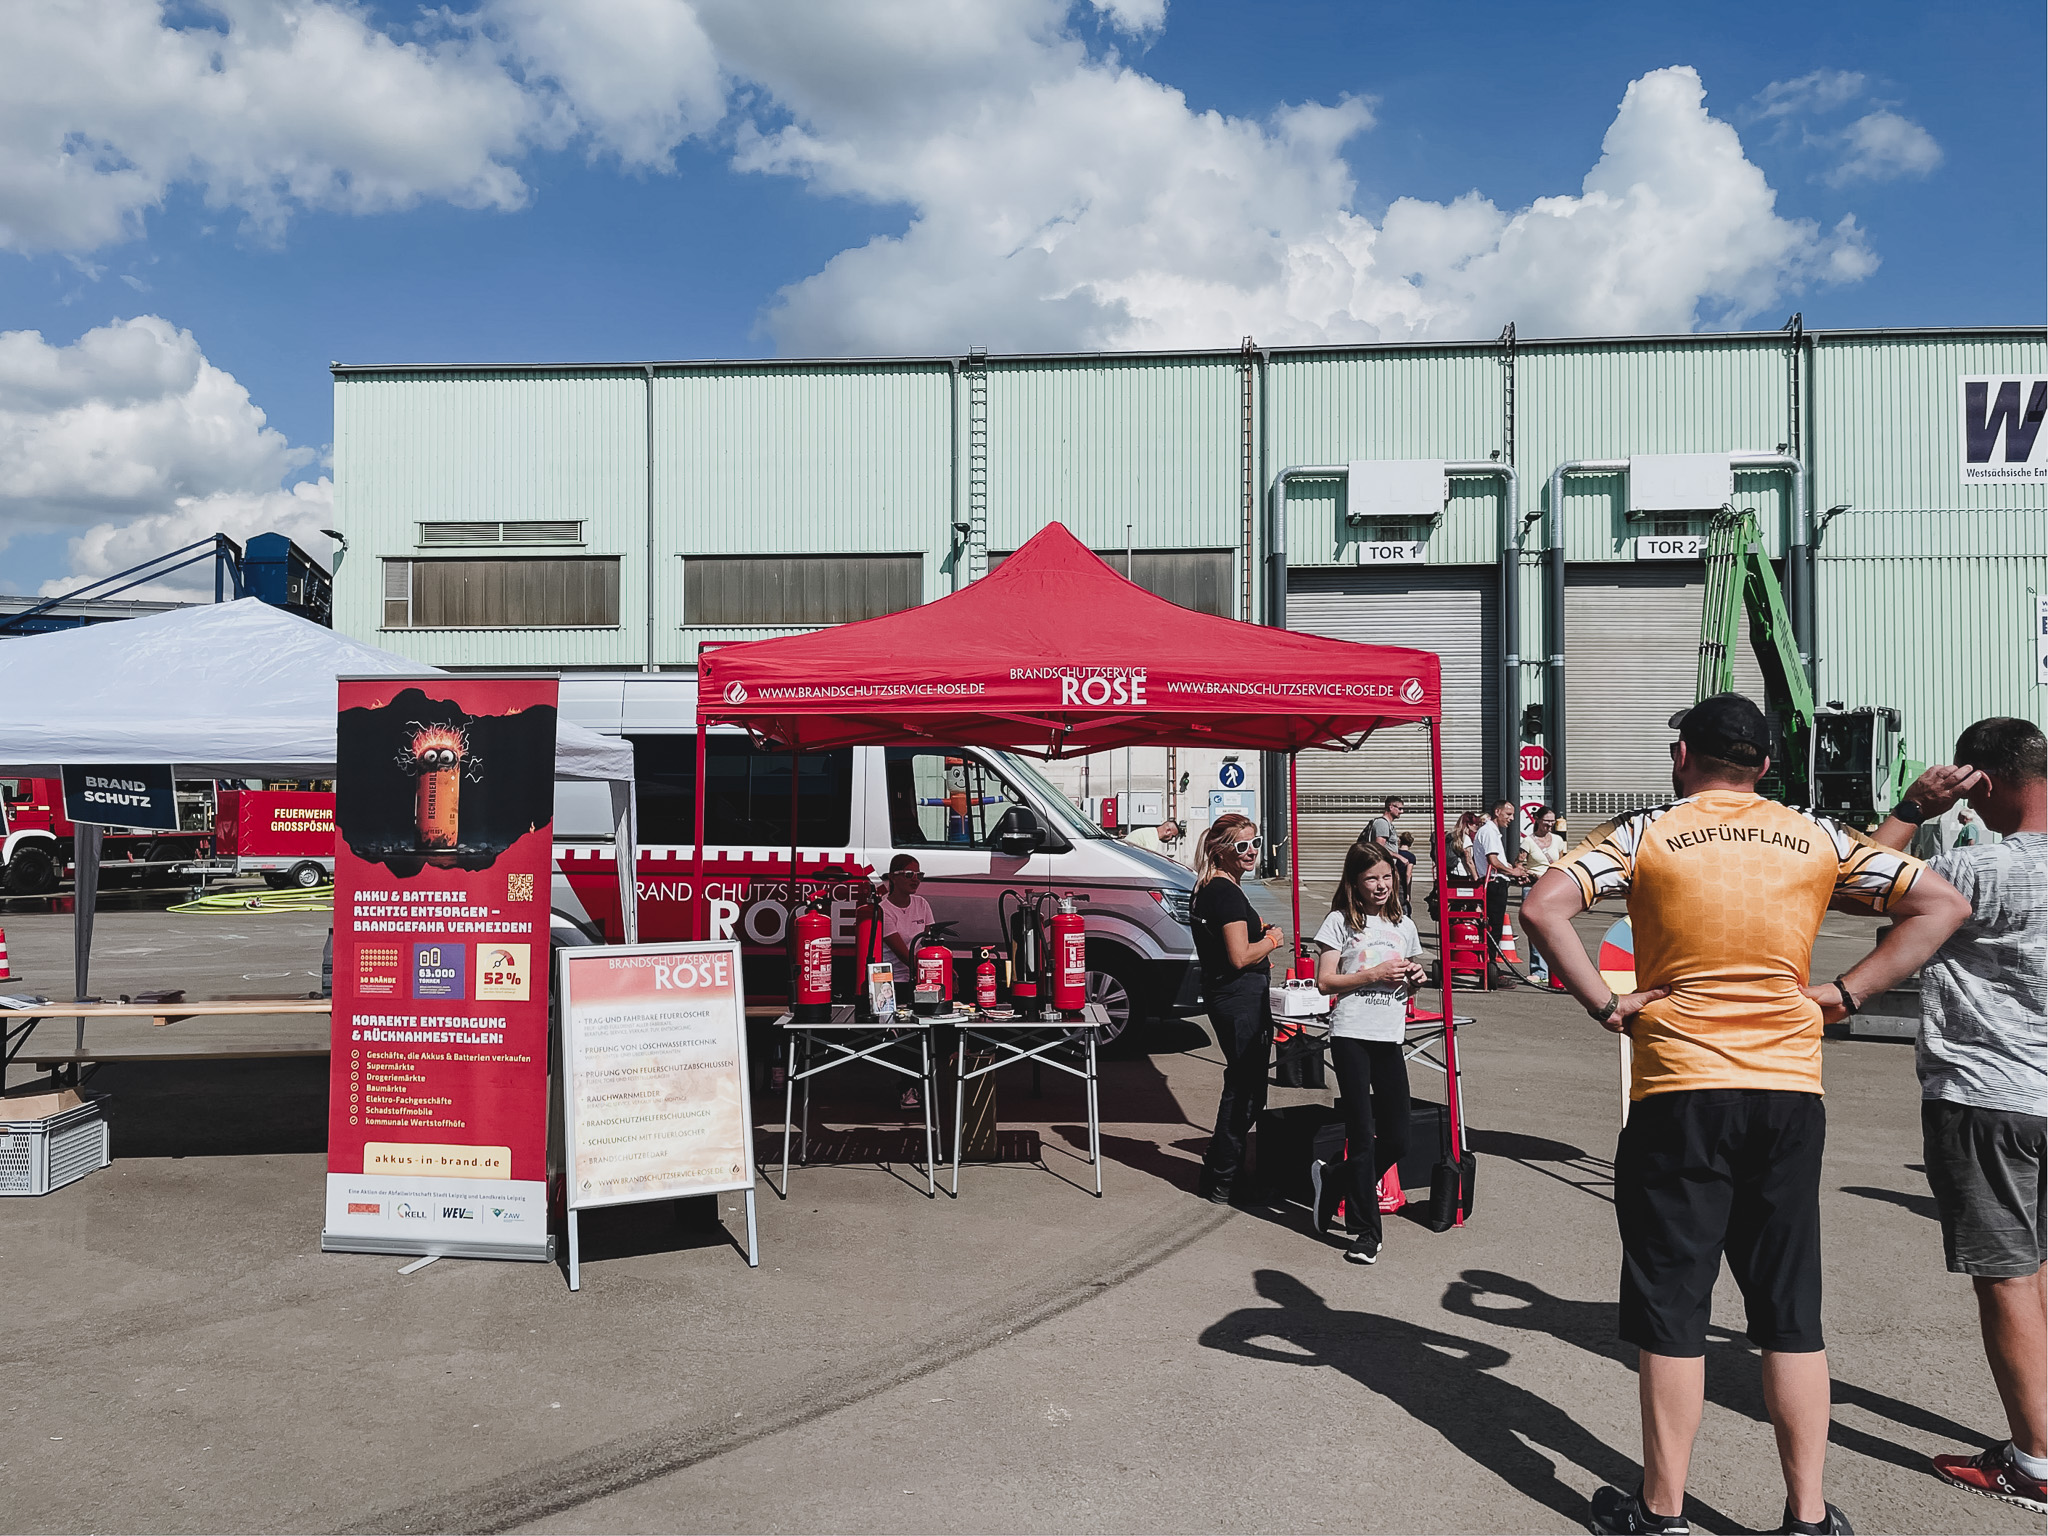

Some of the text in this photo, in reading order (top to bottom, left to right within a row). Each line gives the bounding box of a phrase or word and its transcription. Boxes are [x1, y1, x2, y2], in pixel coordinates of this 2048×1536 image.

[1966, 468, 2031, 477] Westsächsische
[1369, 546, 1418, 559] TOR 1
[1648, 541, 1697, 554] TOR 2
[1009, 666, 1147, 681] BRANDSCHUTZSERVICE
[757, 683, 985, 700] WWW.BRANDSCHUTZSERVICE-ROSE.DE
[1061, 677, 1148, 705] ROSE
[1167, 681, 1394, 698] WWW.BRANDSCHUTZSERVICE-ROSE.DE
[1520, 755, 1549, 771] STOP
[85, 775, 146, 793] BRAND
[83, 790, 152, 808] SCHUTZ
[274, 808, 333, 819] FEUERWEHR
[271, 820, 335, 832] GROSSPÖSNA
[1666, 824, 1810, 855] NEUFÜNFLAND
[353, 891, 467, 902] AKKU & BATTERIE
[353, 906, 408, 917] RICHTIG
[410, 906, 488, 918] ENTSORGEN
[353, 921, 532, 933] BRANDGEFAHR VERMEIDEN!
[709, 900, 857, 944] ROE
[608, 953, 728, 970] BRANDSCHUTZSERVICE
[418, 969, 455, 978] 63.000
[484, 972, 521, 985] 52 %
[654, 962, 729, 990] ROSE
[352, 1015, 506, 1028] KORREKTE ENTSORGUNG
[605, 1015, 621, 1024] UND
[623, 1013, 658, 1023] FAHRBARE
[352, 1028, 504, 1044] & RÜCKNAHMESTELLEN:
[620, 1043, 637, 1052] VON
[366, 1051, 531, 1062] Geschäfte, die Akkus & Batterien verkaufen
[366, 1062, 415, 1071] Supermärkte
[621, 1067, 638, 1076] VON
[366, 1073, 426, 1083] Drogeriemärkte
[366, 1084, 407, 1093] Baumärkte
[366, 1095, 452, 1105] Elektro-Fachgeschäfte
[586, 1090, 660, 1103] RAUCHWARNMELDER
[365, 1106, 433, 1116] Schadstoffmobile
[365, 1117, 466, 1128] kommunale Wertstoffhöfe
[586, 1110, 711, 1127] BRANDSCHUTZHELFERSCHULUNGEN
[588, 1135, 638, 1146] SCHULUNGEN
[639, 1133, 653, 1141] MIT
[375, 1154, 500, 1168] akkus-in-brand.de
[588, 1150, 668, 1164] BRANDSCHUTZBEDARF
[599, 1166, 724, 1186] WWW.BRANDSCHUTZSERVICE-ROSE.DE
[404, 1211, 427, 1219] KELL
[442, 1207, 467, 1219] WEV
